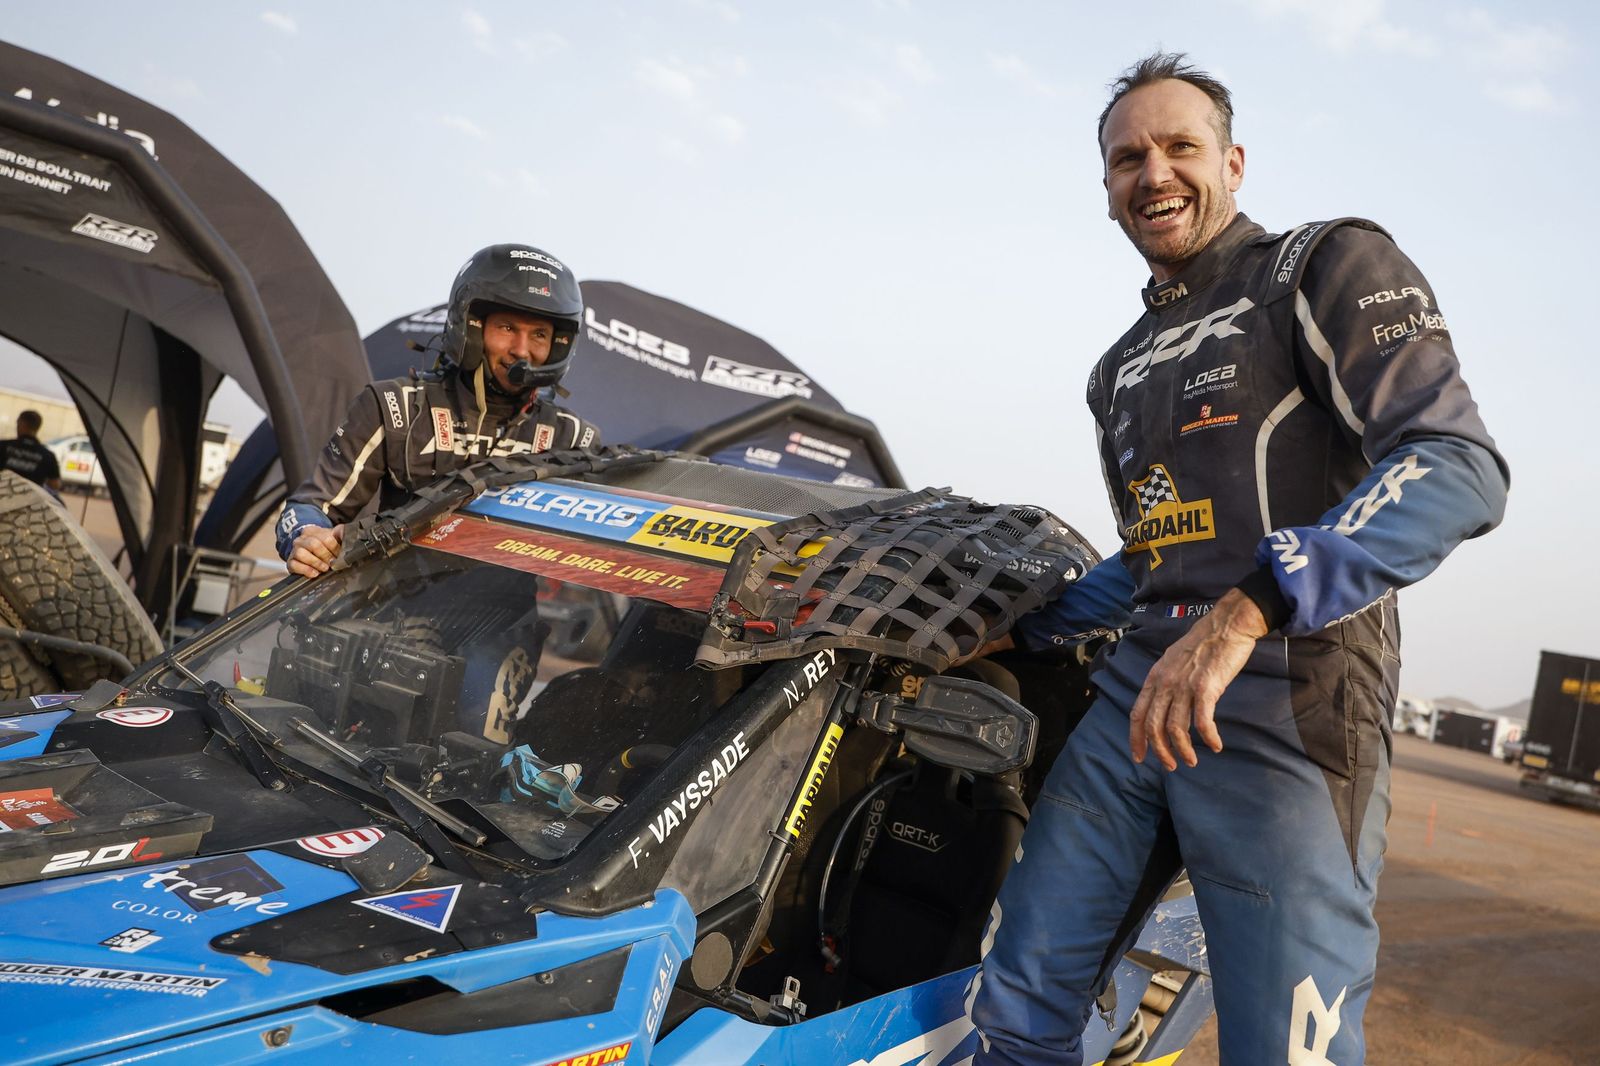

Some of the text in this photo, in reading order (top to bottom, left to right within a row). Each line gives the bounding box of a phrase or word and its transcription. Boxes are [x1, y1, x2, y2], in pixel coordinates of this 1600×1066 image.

[16, 153, 36, 169] DE
[14, 169, 72, 195] BONNET
[510, 250, 563, 271] sparco
[1277, 223, 1326, 284] sparco
[519, 265, 557, 280] POLARIS
[1149, 282, 1188, 306] LFM
[1108, 296, 1255, 415] RZR
[1184, 364, 1237, 391] LOEB
[384, 391, 404, 428] sparco
[1205, 414, 1239, 425] MARTIN
[437, 413, 450, 447] SIMPSON
[494, 539, 692, 590] DREAM. DARE. LIVE IT.
[782, 647, 837, 709] N. REY
[648, 730, 750, 845] VAYSSADE
[892, 821, 940, 848] QRT-K
[40, 837, 163, 874] 2.0L
[628, 836, 650, 870] F.
[112, 900, 199, 925] COLOR
[69, 979, 209, 998] ENTREPRENEUR
[91, 970, 221, 989] MARTIN
